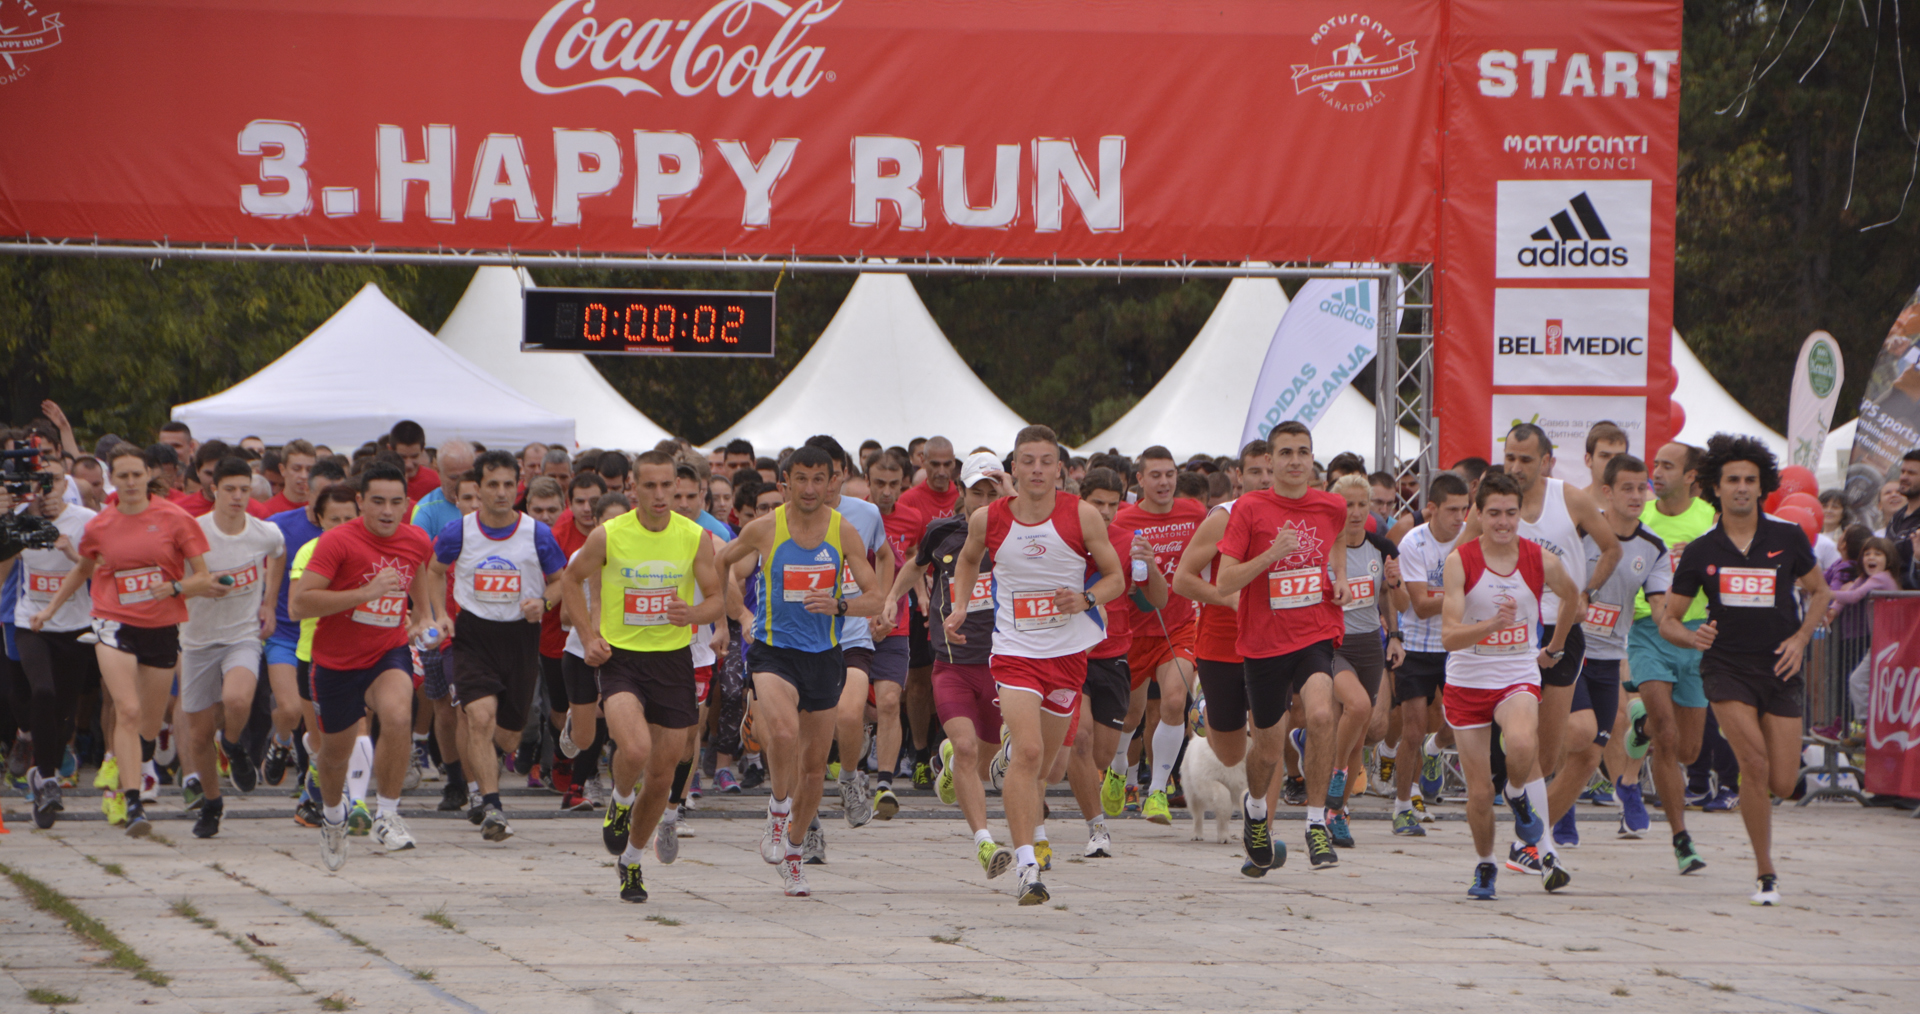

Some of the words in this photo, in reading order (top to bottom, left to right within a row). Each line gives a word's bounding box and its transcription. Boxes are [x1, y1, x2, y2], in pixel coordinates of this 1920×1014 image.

[22, 37, 44, 48] RUN
[519, 0, 844, 99] Coca-Cola
[1349, 68, 1379, 77] HAPPY
[1380, 64, 1399, 76] RUN
[1477, 48, 1680, 99] START
[1318, 90, 1386, 112] MARATONCI
[1524, 156, 1636, 171] MARATONCI
[375, 123, 801, 231] HAPPY
[849, 133, 1127, 235] RUN
[1517, 239, 1629, 267] adidas
[583, 303, 745, 343] 0:00:02
[1319, 298, 1376, 330] adidas
[1498, 336, 1545, 356] BEL
[1563, 336, 1644, 356] MEDIC
[1257, 362, 1318, 441] ADIDAS
[1538, 418, 1570, 428] Савез
[1571, 419, 1584, 428] за
[1859, 398, 1881, 417] PS
[1877, 413, 1920, 447] sports
[1546, 430, 1585, 439] фитнес
[1153, 541, 1184, 554] Coca-Cola
[482, 576, 520, 592] 774
[620, 567, 684, 583] Champion
[808, 573, 822, 588] 7
[1279, 575, 1322, 596] 872
[1729, 576, 1774, 594] 962
[366, 599, 404, 615] 404
[1487, 627, 1526, 644] 308
